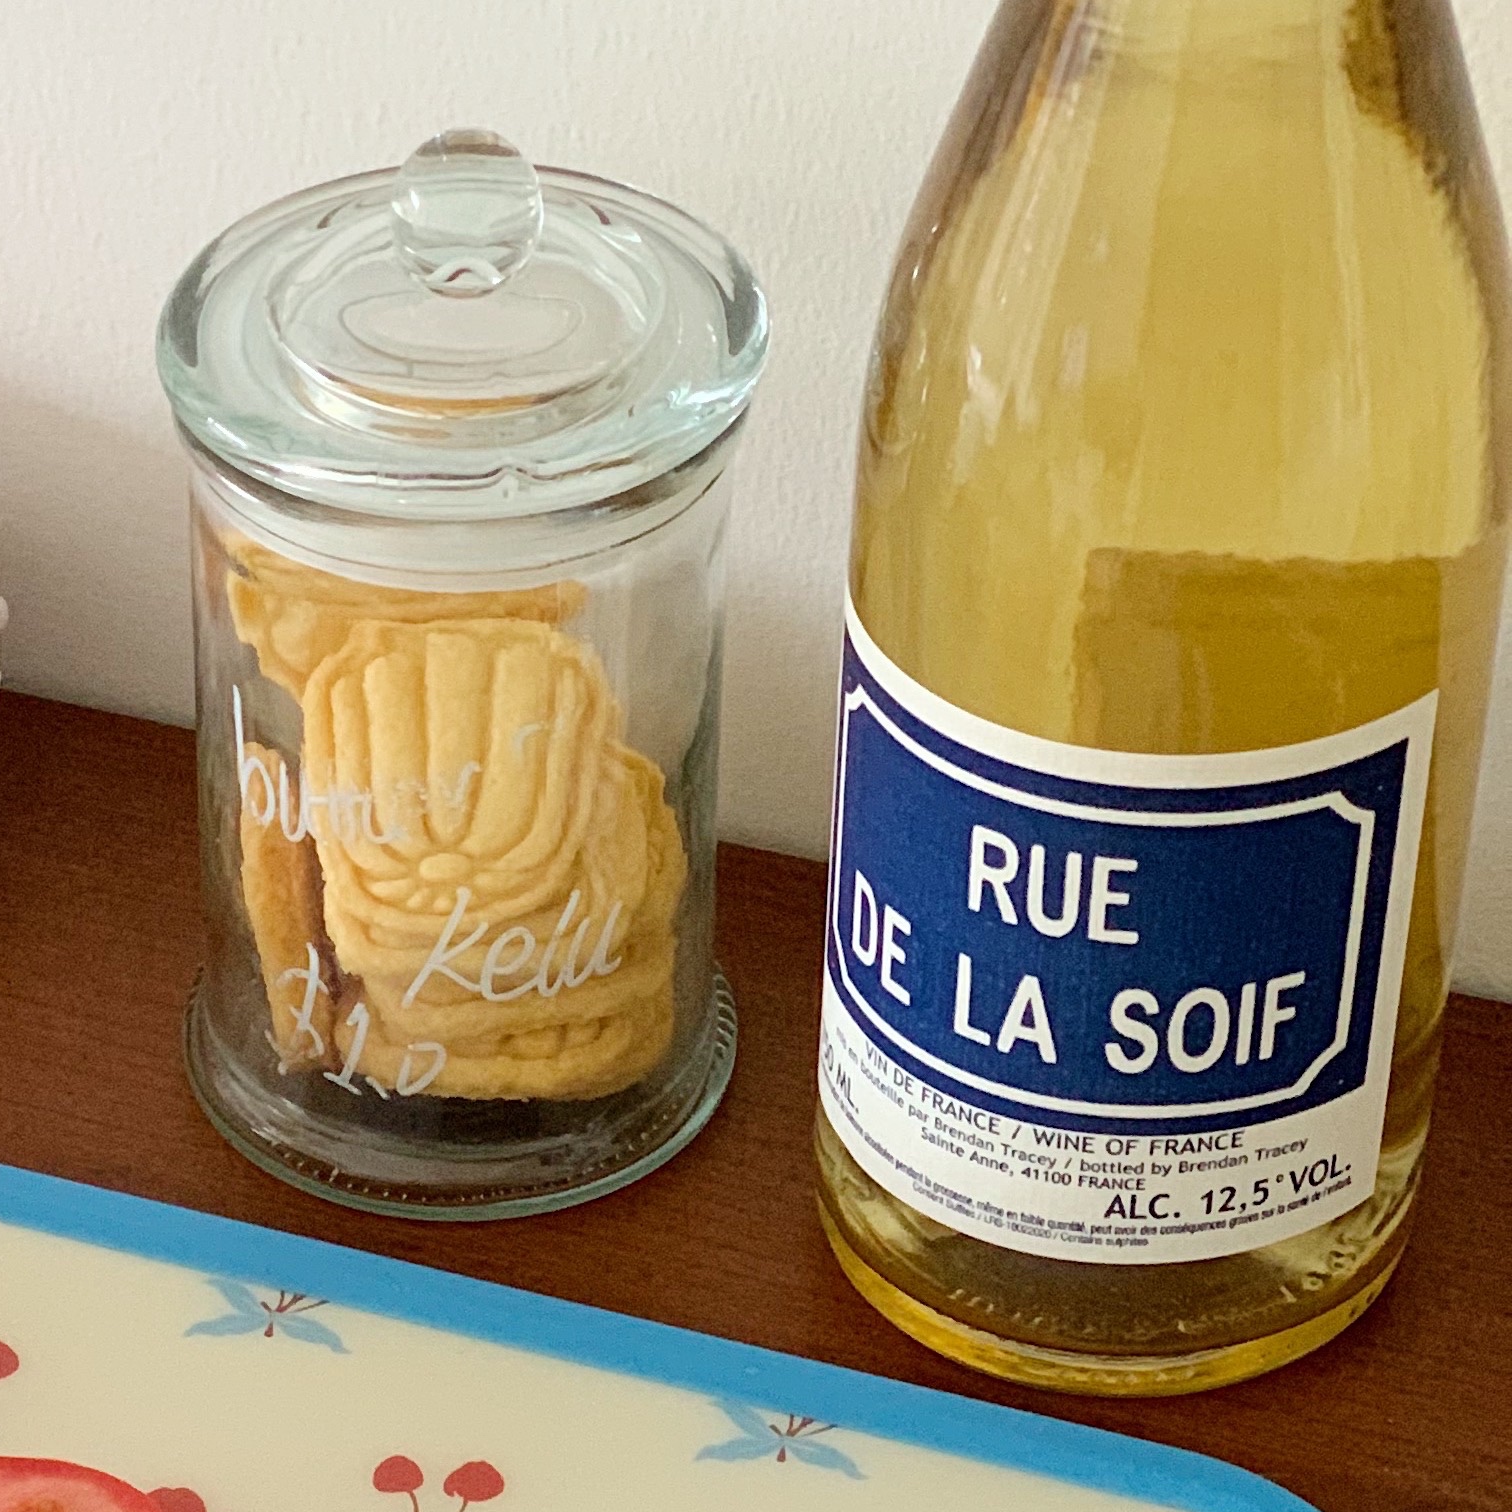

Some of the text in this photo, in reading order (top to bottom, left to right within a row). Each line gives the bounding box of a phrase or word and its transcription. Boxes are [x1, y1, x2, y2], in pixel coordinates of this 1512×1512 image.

[967, 823, 1139, 945] RUE
[851, 869, 1306, 1075] DE LA SOIF
[864, 1039, 1246, 1156] VIN DE FRANCE / WINE OF FRANCE
[908, 1104, 929, 1124] par
[934, 1117, 995, 1152] Brendan
[1000, 1143, 1058, 1170] Tracey
[1079, 1157, 1145, 1176] bottled
[1151, 1162, 1172, 1178] by
[1178, 1154, 1249, 1174] Brendan
[1255, 1138, 1309, 1161] Tracey
[920, 1126, 1146, 1191] Sainte Anne, 41100 FRANCE
[1103, 1193, 1181, 1220] ALC.
